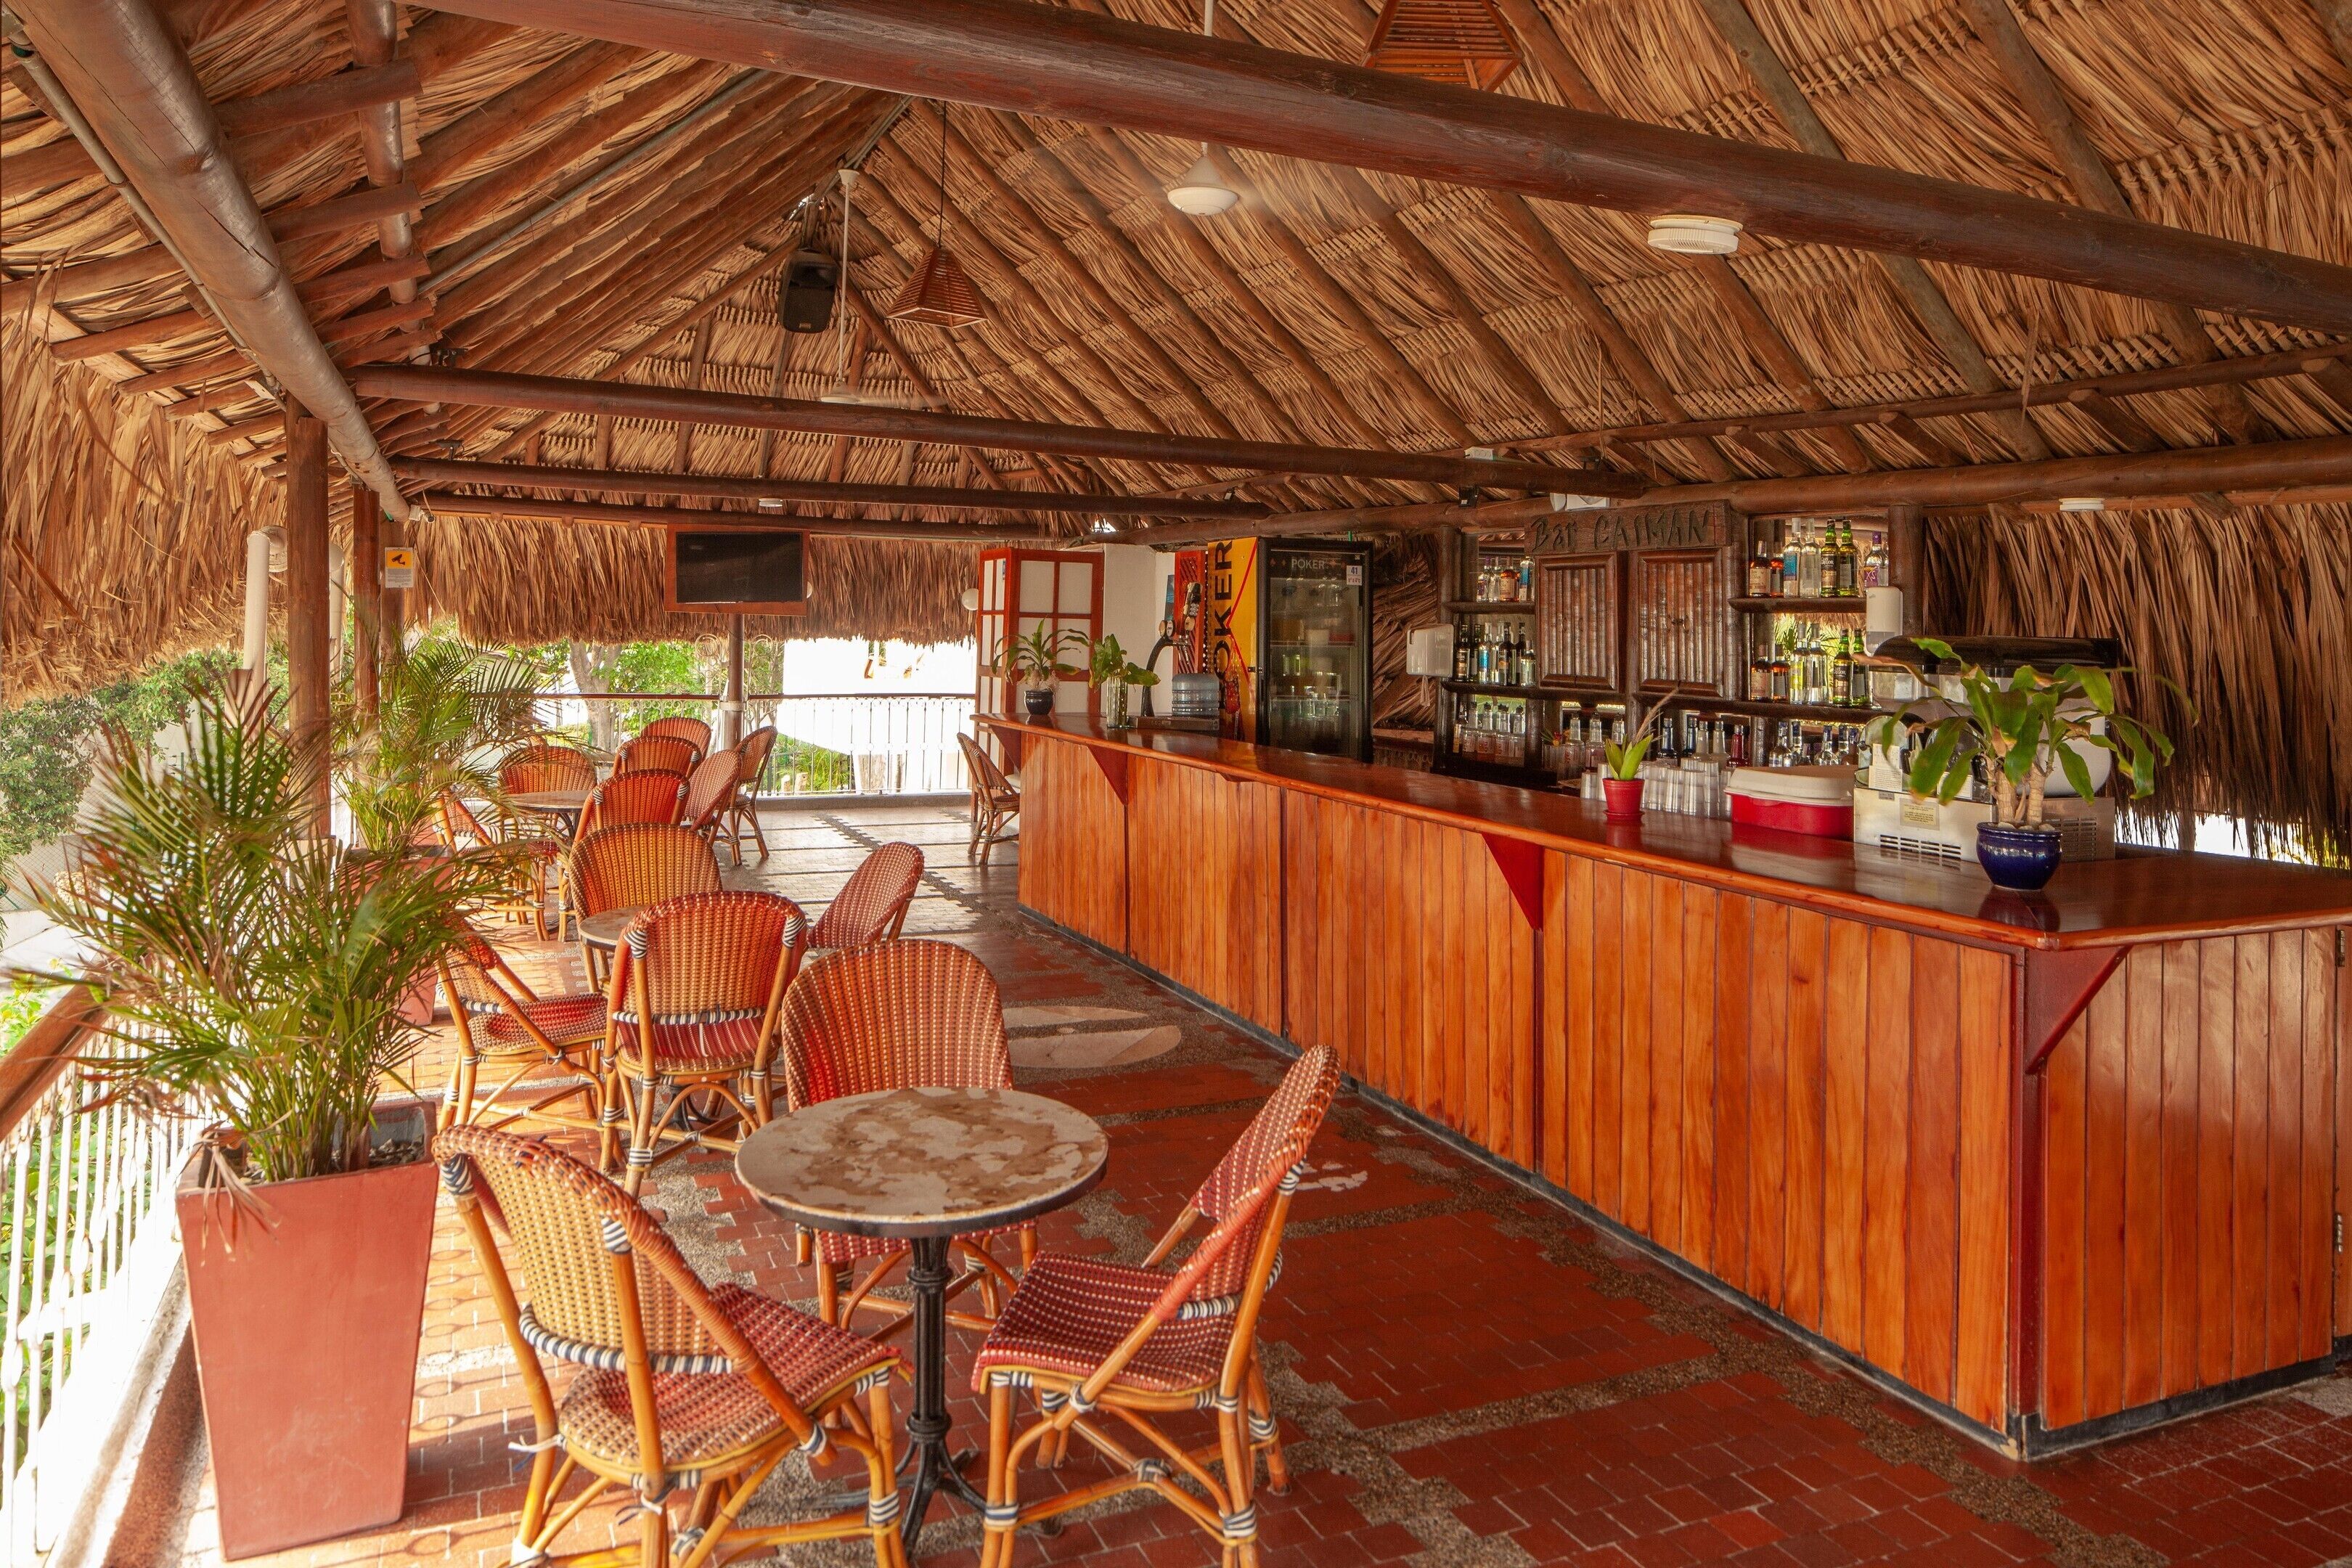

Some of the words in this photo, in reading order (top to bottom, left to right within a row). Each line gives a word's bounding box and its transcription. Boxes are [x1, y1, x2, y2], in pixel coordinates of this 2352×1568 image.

[1530, 515, 1578, 552] Bar
[1594, 508, 1710, 550] CAIMAN
[1291, 558, 1326, 570] POKER
[1351, 566, 1357, 575] 41
